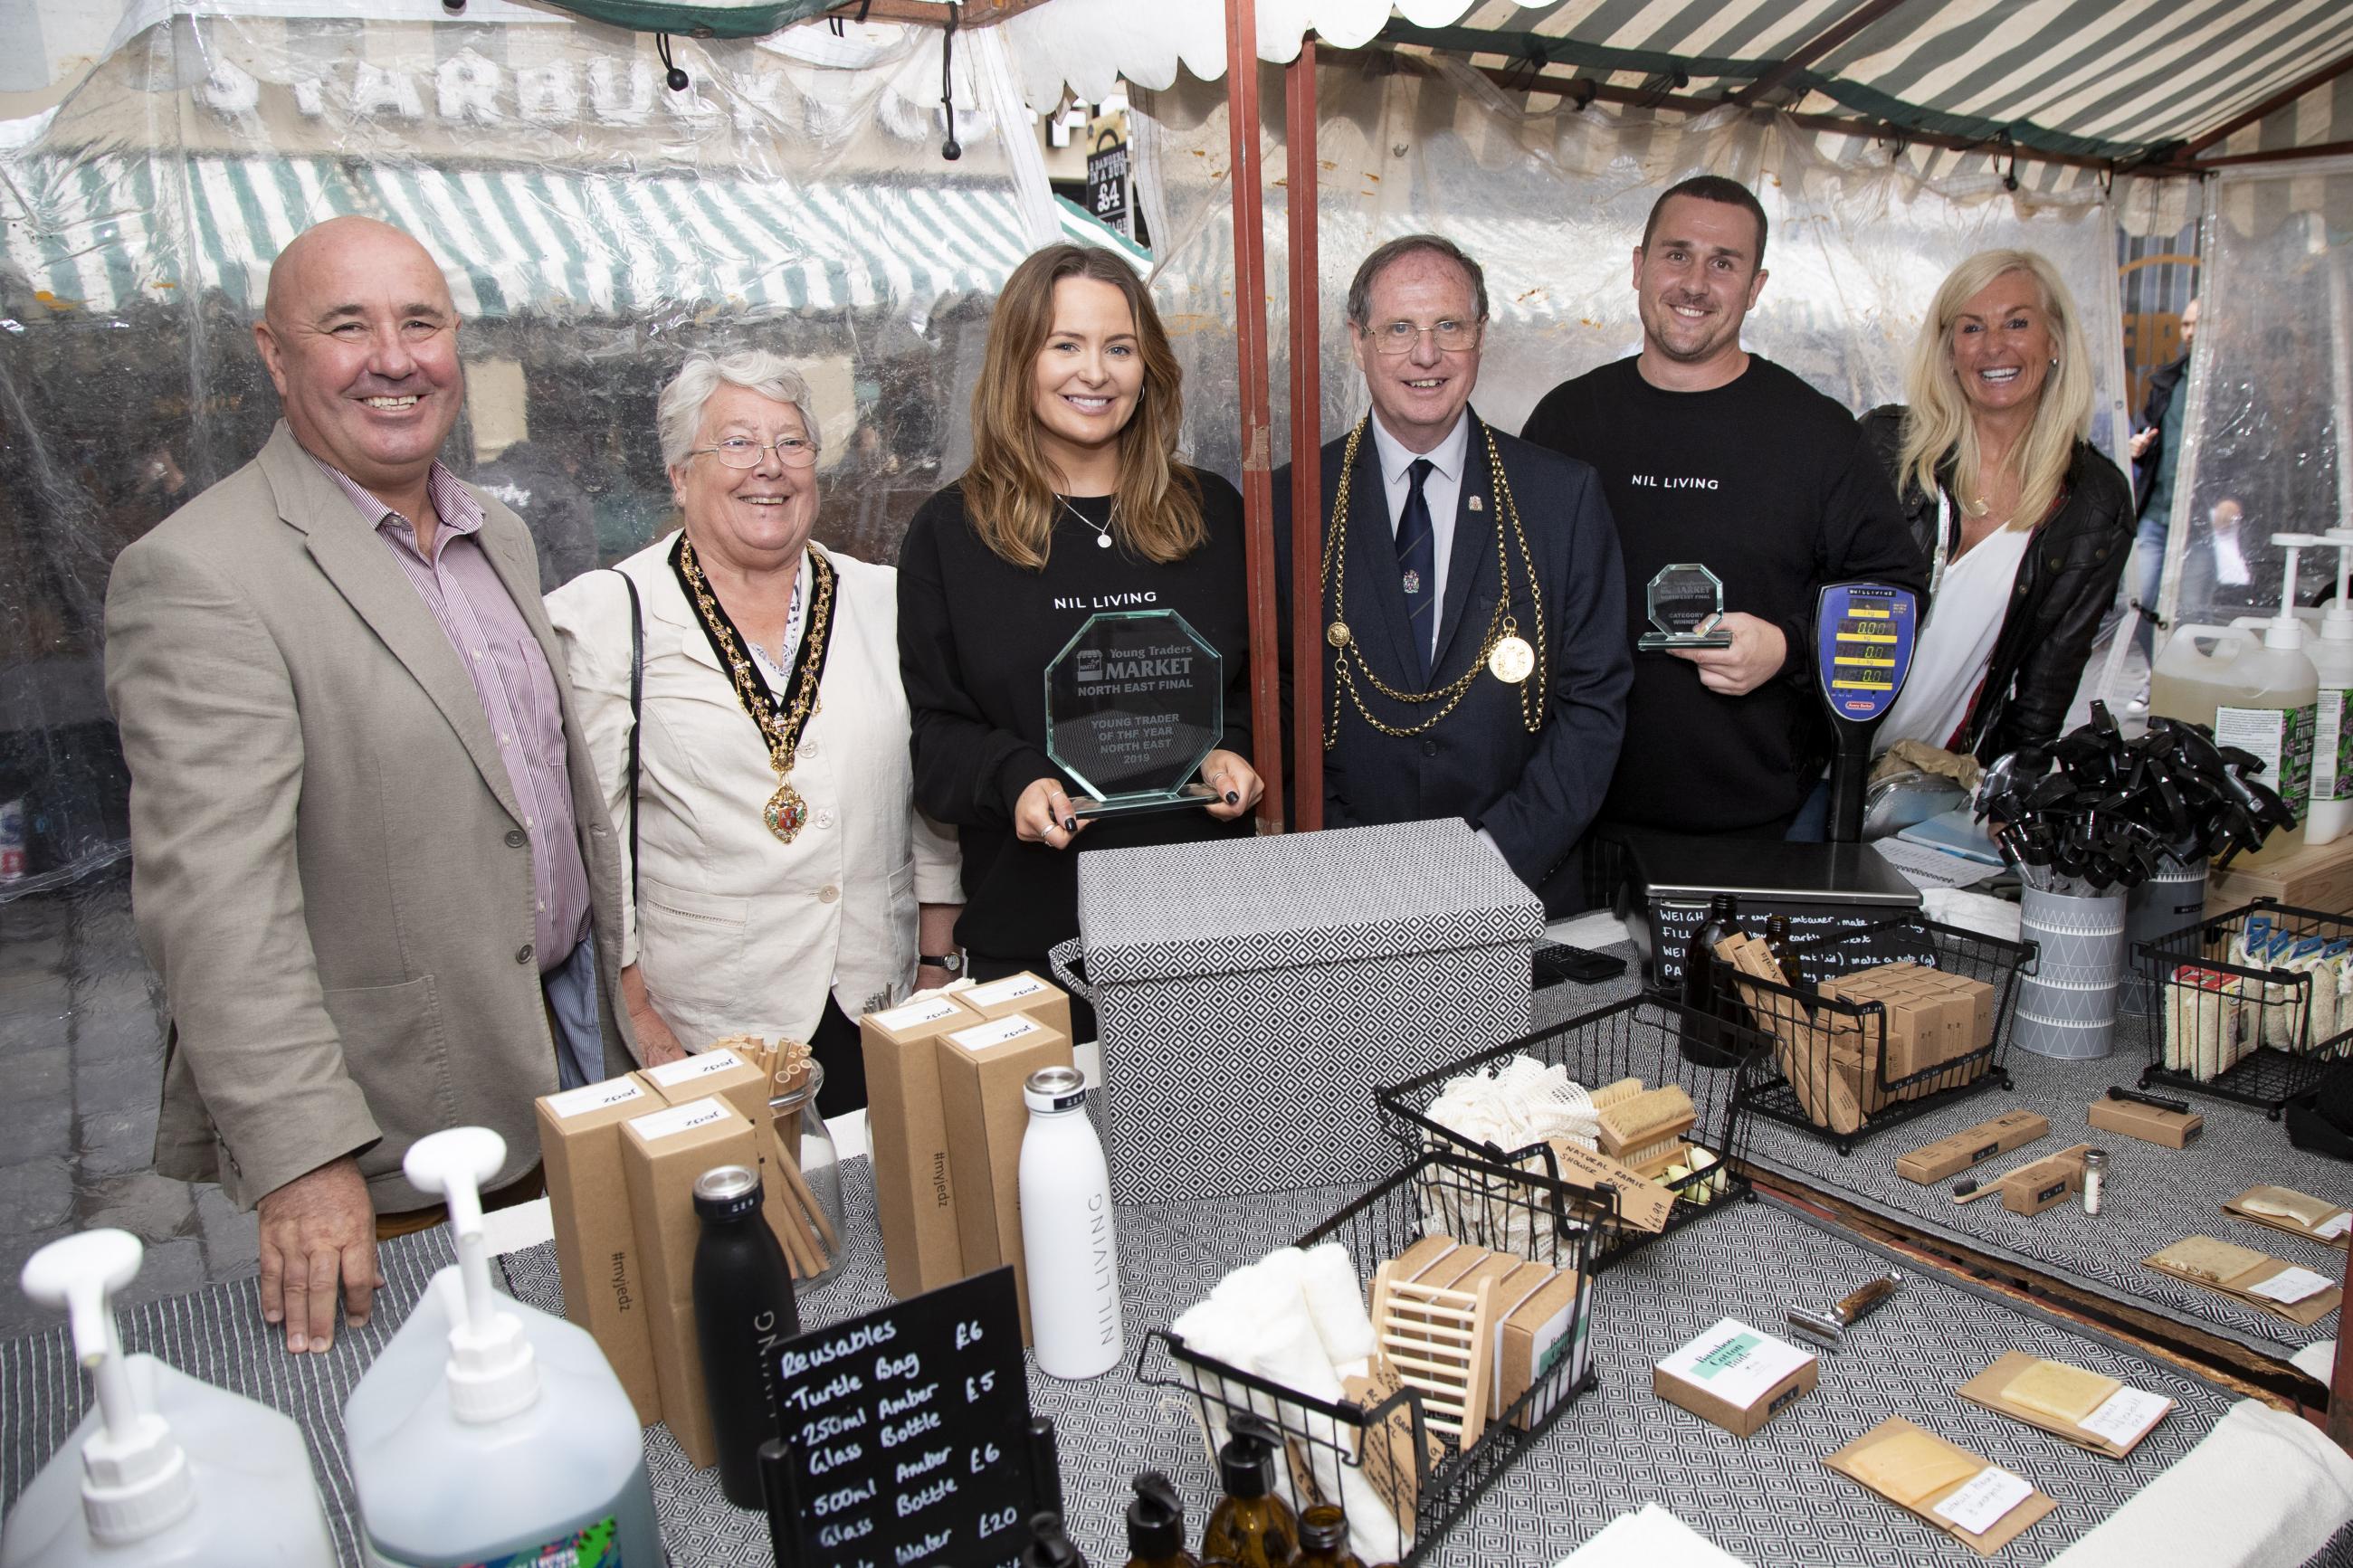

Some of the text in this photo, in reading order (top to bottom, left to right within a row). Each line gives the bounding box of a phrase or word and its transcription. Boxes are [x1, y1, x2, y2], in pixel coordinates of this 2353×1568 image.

[1097, 180, 1120, 213] £4
[1632, 474, 1720, 490] NIL LIVING
[1053, 591, 1157, 610] NIL LIVING
[1110, 644, 1193, 660] Young Traders
[1105, 658, 1193, 680] MARKET
[1078, 679, 1194, 697] NORTH EAST FINAL
[1091, 713, 1180, 729] YOUNG TRADER
[1099, 727, 1174, 742] OF THE YEAR
[1100, 738, 1172, 754] NORTH EAST
[1124, 753, 1150, 765] 2019
[1660, 909, 1704, 922] WEIGH
[1662, 927, 1691, 939] FILL
[1662, 946, 1685, 958] WEI
[1664, 964, 1682, 976] PA
[1559, 1153, 1597, 1177] SHOWER
[1565, 1144, 1609, 1172] NATURAL
[1615, 1171, 1645, 1191] RAMIE
[933, 1151, 950, 1209] #myjedz
[1088, 1193, 1115, 1346] NIL LIVING
[611, 1252, 633, 1314] #myjedz
[781, 1319, 898, 1380] Reusables
[1695, 1335, 1736, 1364] Bamboo
[1710, 1344, 1745, 1368] Cotton
[791, 1319, 984, 1411] Turtle Bag £6
[802, 1369, 996, 1448] 250ml Amber £5
[809, 1411, 942, 1476] Glass Bottle
[814, 1441, 1000, 1517] 500ml Amber £6
[820, 1478, 958, 1549] Glass Bottle
[894, 1506, 1018, 1566] Water £20
